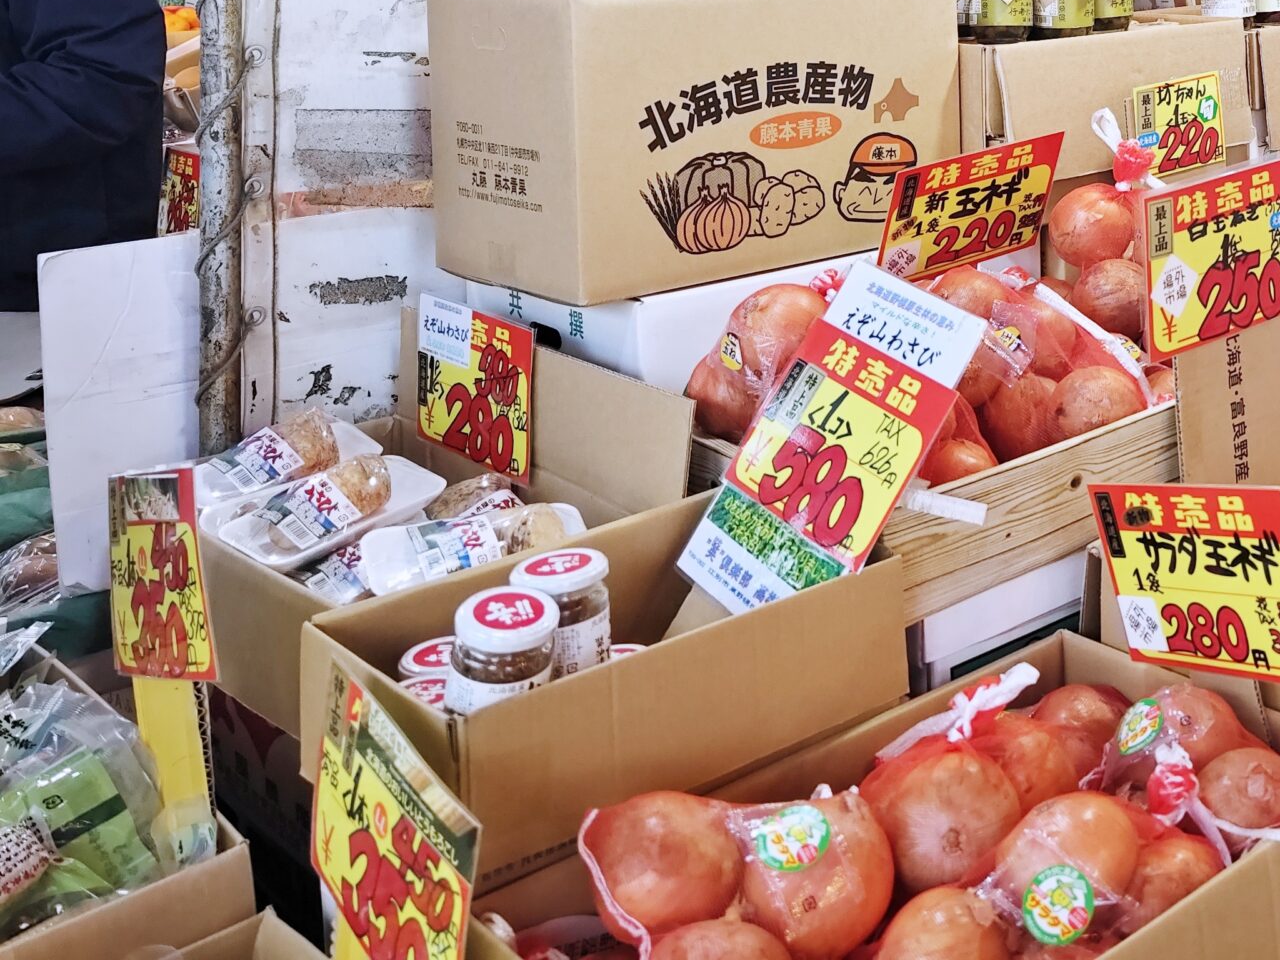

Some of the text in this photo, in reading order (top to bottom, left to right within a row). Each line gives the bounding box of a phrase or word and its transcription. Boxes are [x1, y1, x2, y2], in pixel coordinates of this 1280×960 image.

[638, 60, 875, 154] 北海道農産物
[1140, 93, 1153, 130] 最上品
[1156, 80, 1207, 106] 坊ちゃん
[758, 116, 834, 146] 藤本青果
[871, 146, 897, 161] 藤本
[1158, 119, 1220, 173] 220
[925, 144, 1034, 190] 特売品
[924, 167, 1030, 220] 新玉ネギ
[1177, 170, 1275, 224] 特売品
[925, 209, 1024, 270] 220 円
[1154, 205, 1168, 254] 最上品
[423, 315, 470, 342] えぞ山わさび
[841, 306, 942, 368] えぞ山わさび
[821, 337, 924, 417] 特売品
[442, 382, 515, 473] 280
[874, 411, 905, 447] TAX
[758, 423, 865, 548] 580
[1124, 492, 1255, 532] 特売品
[186, 609, 207, 643] 378
[1160, 601, 1250, 663] 280
[1251, 648, 1271, 671] 円
